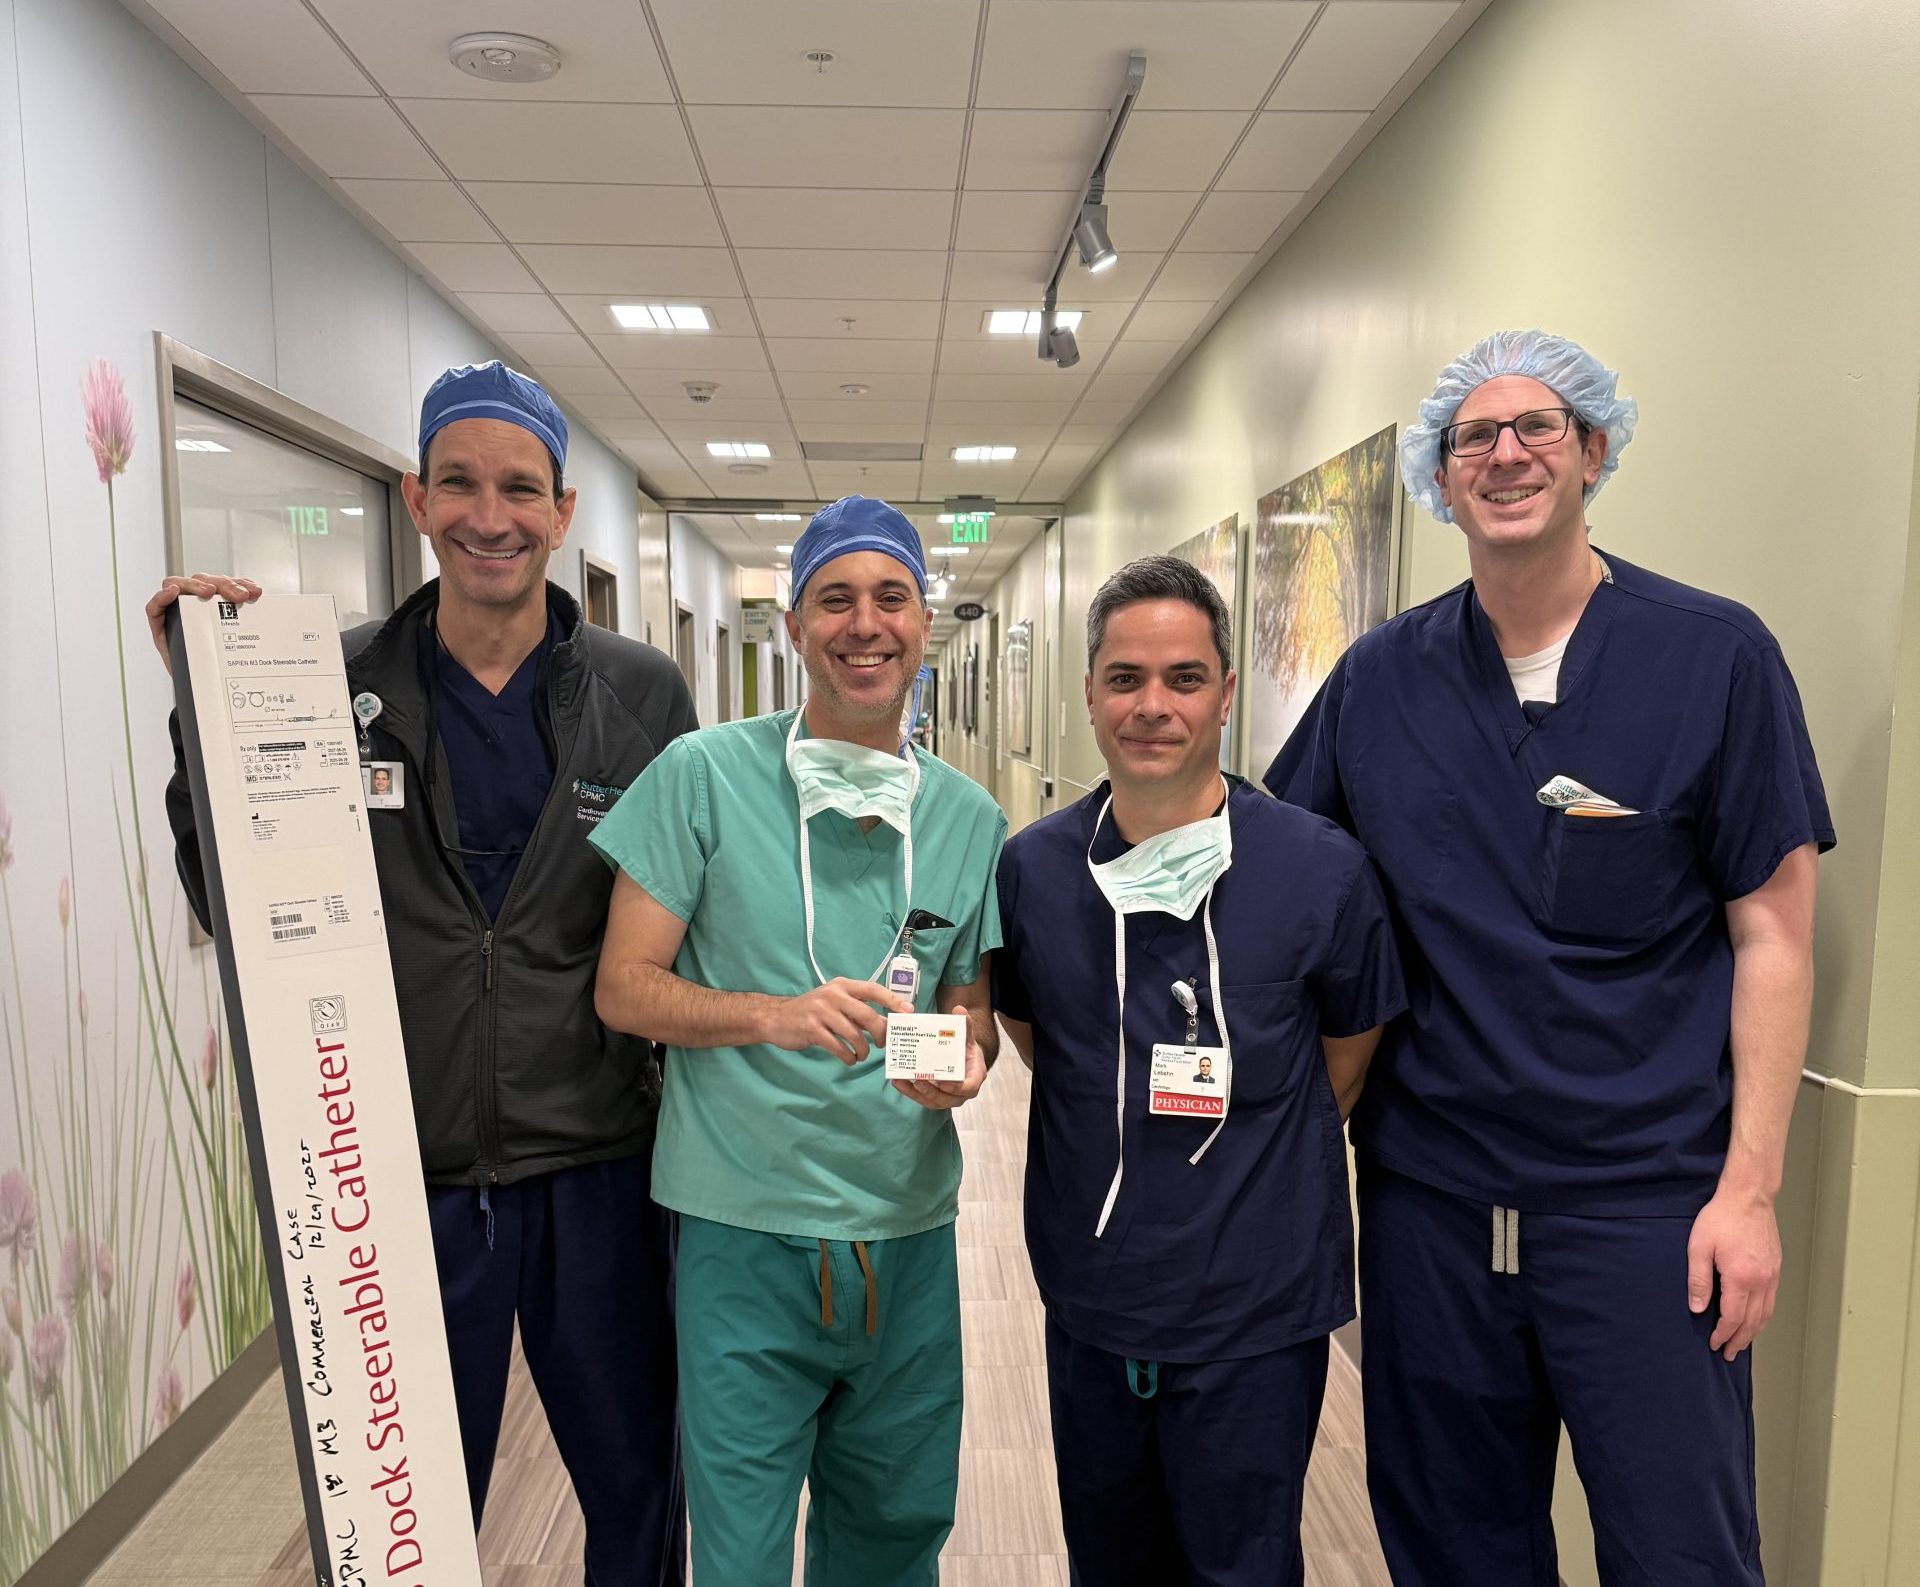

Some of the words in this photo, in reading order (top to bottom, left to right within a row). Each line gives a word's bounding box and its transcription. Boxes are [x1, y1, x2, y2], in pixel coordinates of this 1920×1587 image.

[952, 512, 990, 543] EXIT
[959, 606, 979, 617] 440
[580, 789, 606, 802] CPMC
[581, 781, 609, 793] Sutter
[1553, 780, 1580, 797] Sutter
[1155, 1097, 1221, 1111] PHYSICIAN
[315, 1037, 371, 1232] Catheter
[300, 1138, 327, 1249] 12/29/2025
[286, 1208, 304, 1260] CASE
[301, 1273, 333, 1397] COMMERCIAL
[339, 1242, 404, 1451] Steerable
[316, 1418, 340, 1455] M3
[370, 1455, 423, 1577] Dock
